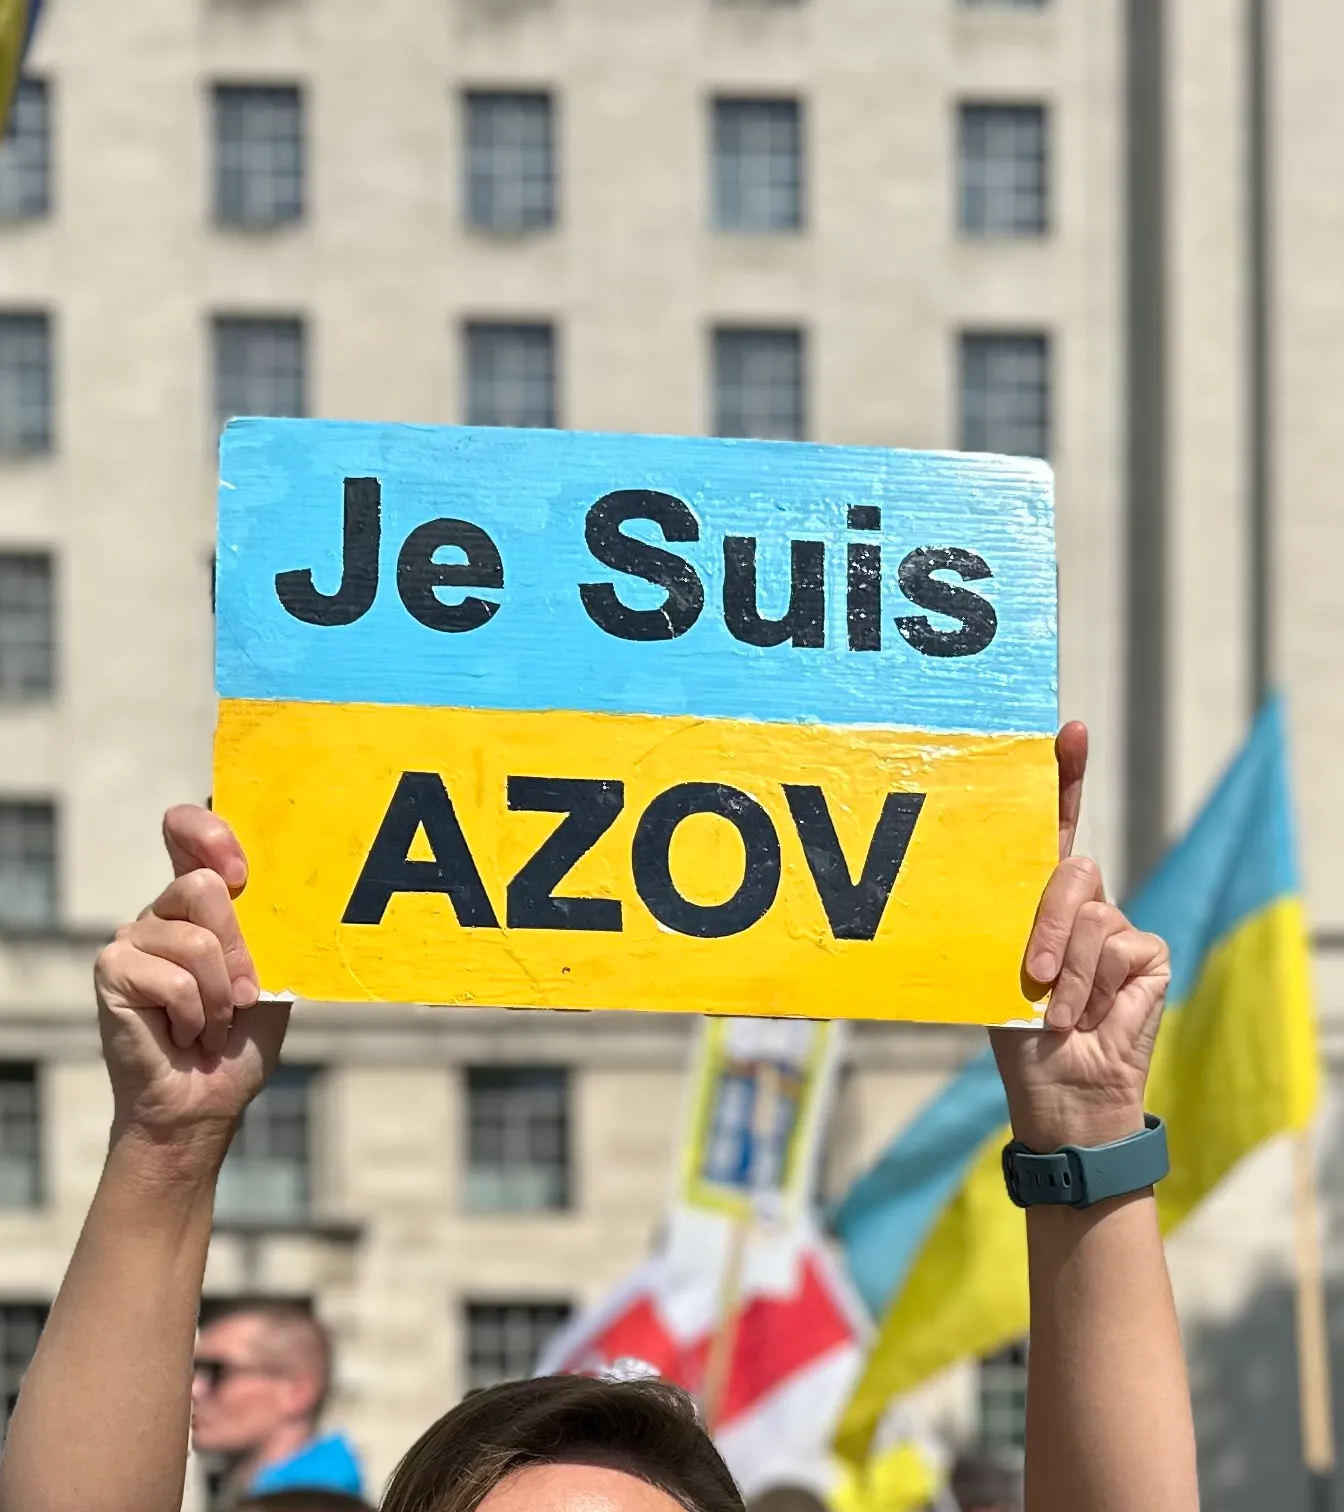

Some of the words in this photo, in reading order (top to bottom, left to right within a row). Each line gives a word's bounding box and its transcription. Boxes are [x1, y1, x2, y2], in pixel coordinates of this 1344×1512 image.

[275, 477, 505, 634] Je
[578, 489, 998, 658] Suis
[341, 771, 926, 942] AZOV
